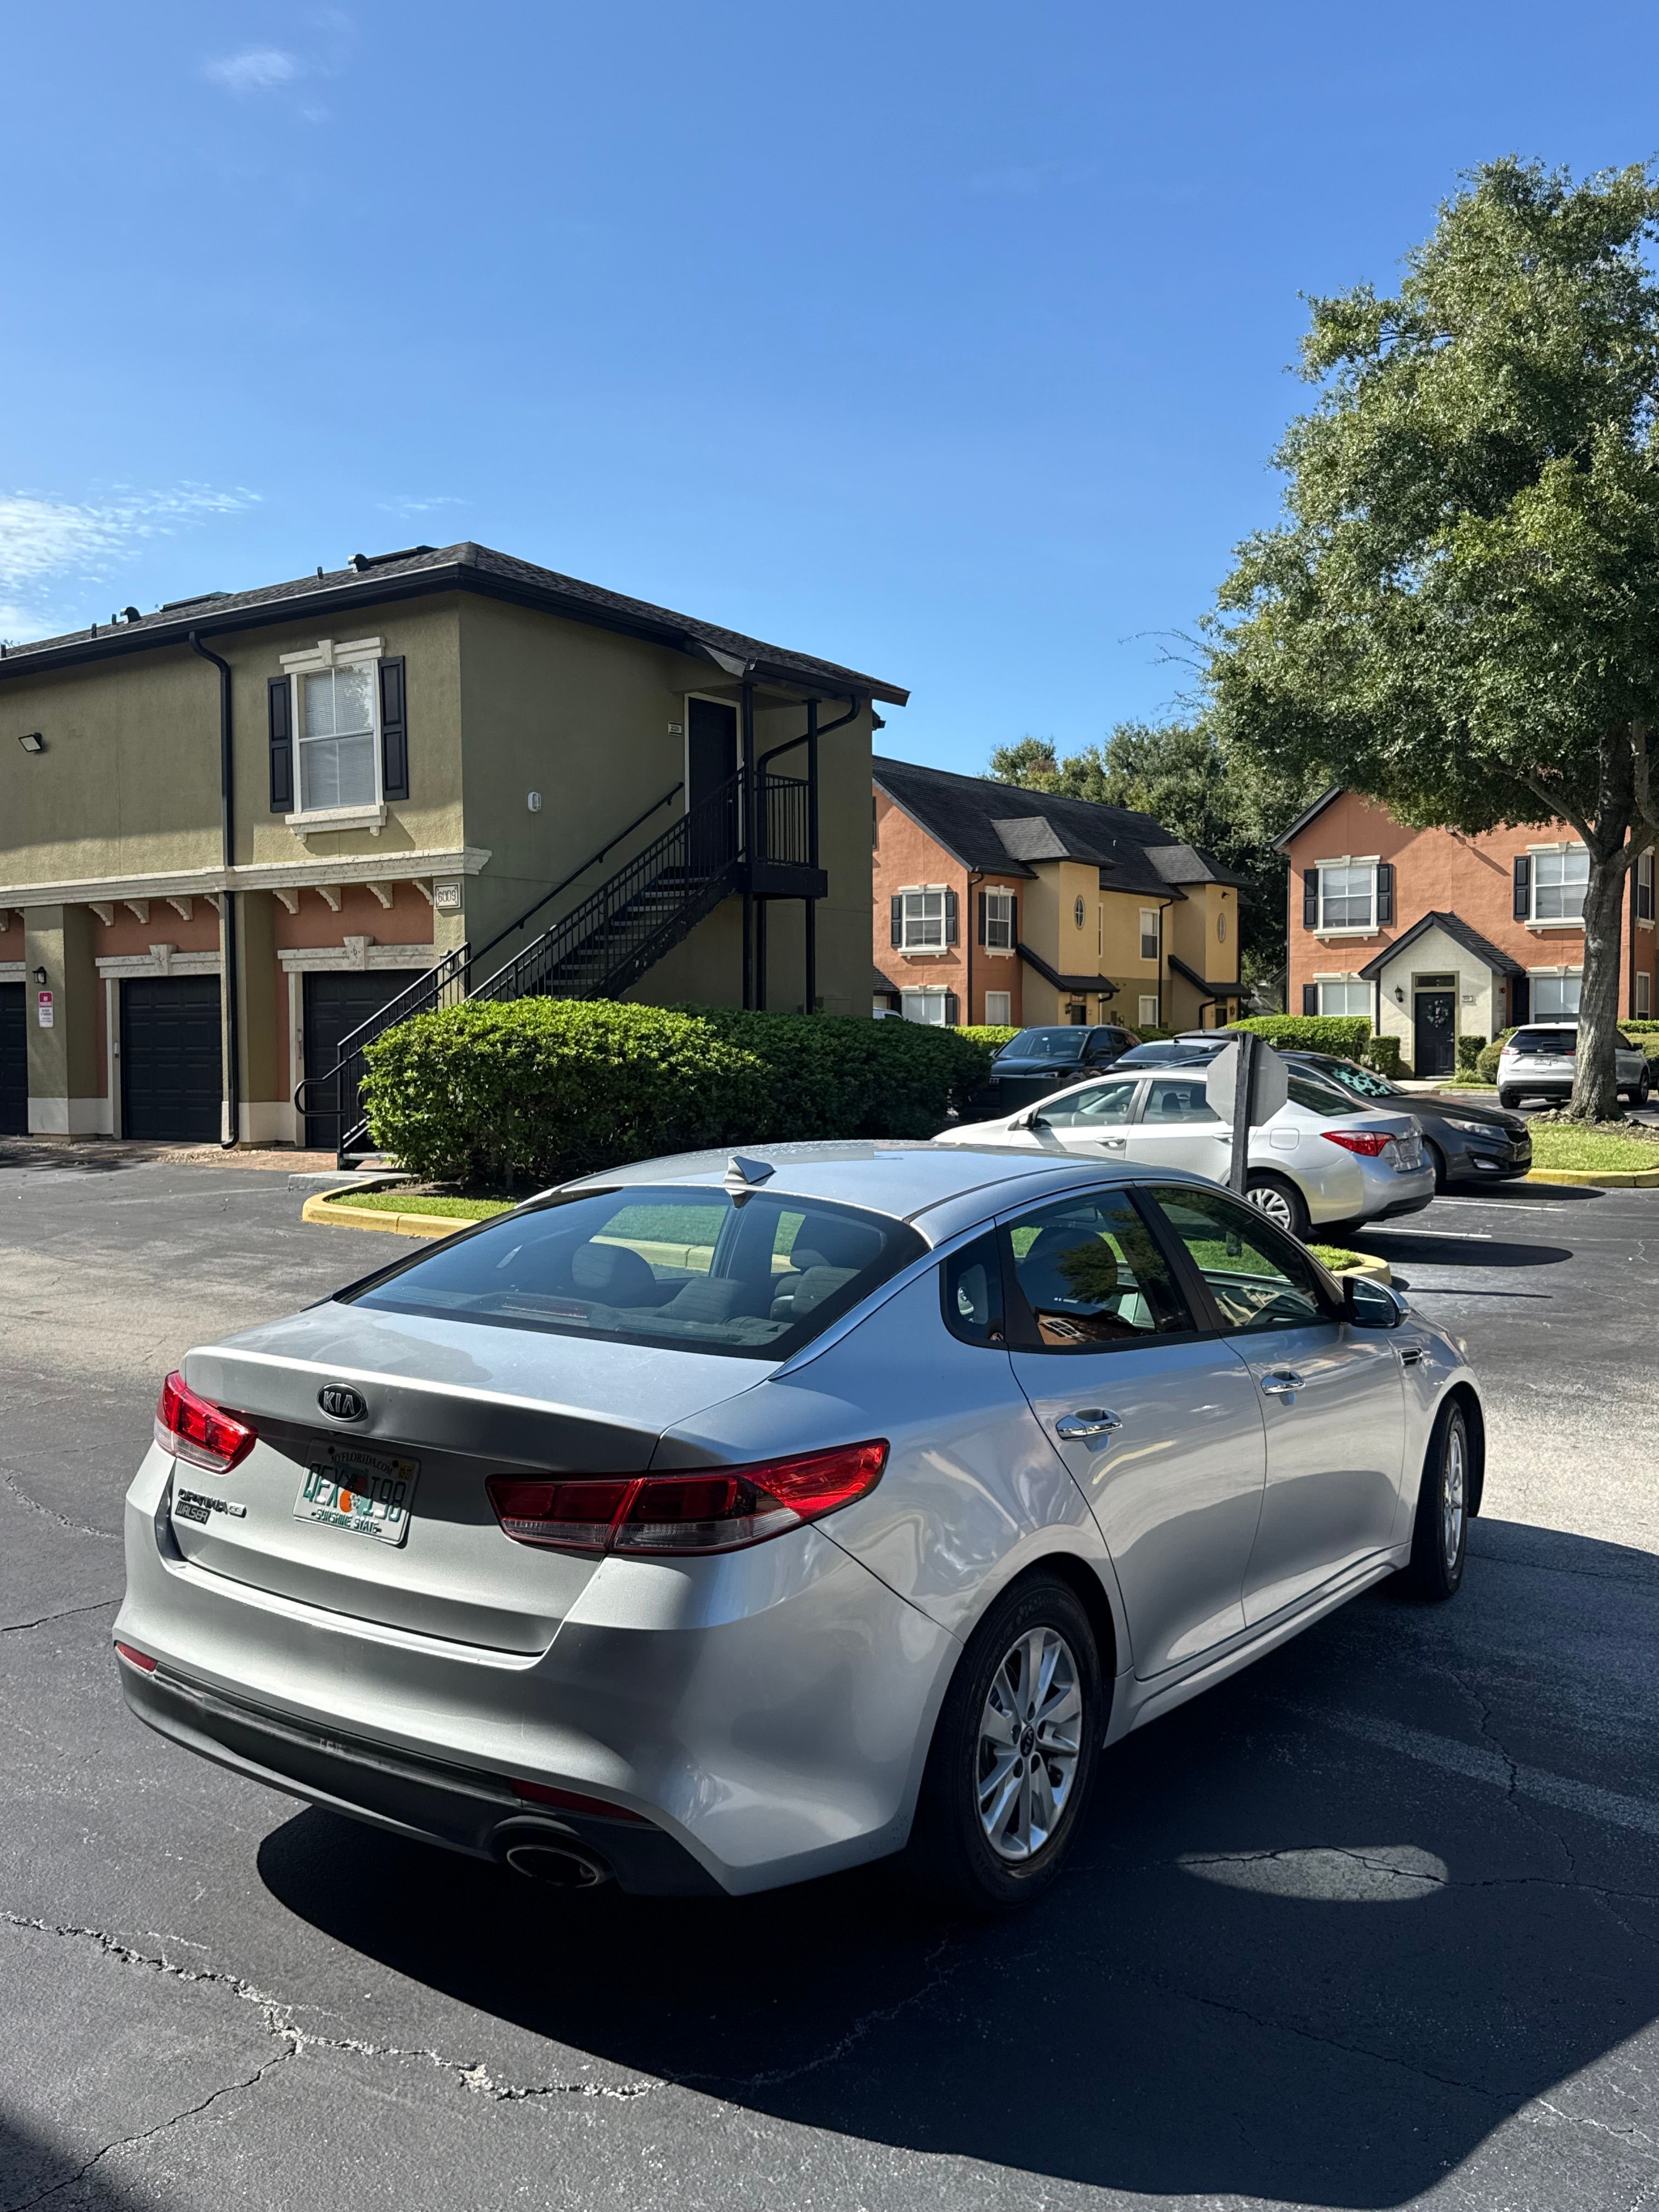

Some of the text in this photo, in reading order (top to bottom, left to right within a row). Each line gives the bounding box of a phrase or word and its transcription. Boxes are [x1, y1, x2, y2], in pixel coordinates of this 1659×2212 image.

[438, 890, 456, 902] 6009
[323, 1391, 356, 1414] KIA
[176, 1502, 208, 1522] WALSER
[178, 1487, 228, 1515] OPTIMA
[316, 1507, 379, 1534] SUNSHINE STATE
[1024, 1730, 1034, 1754] KIA
